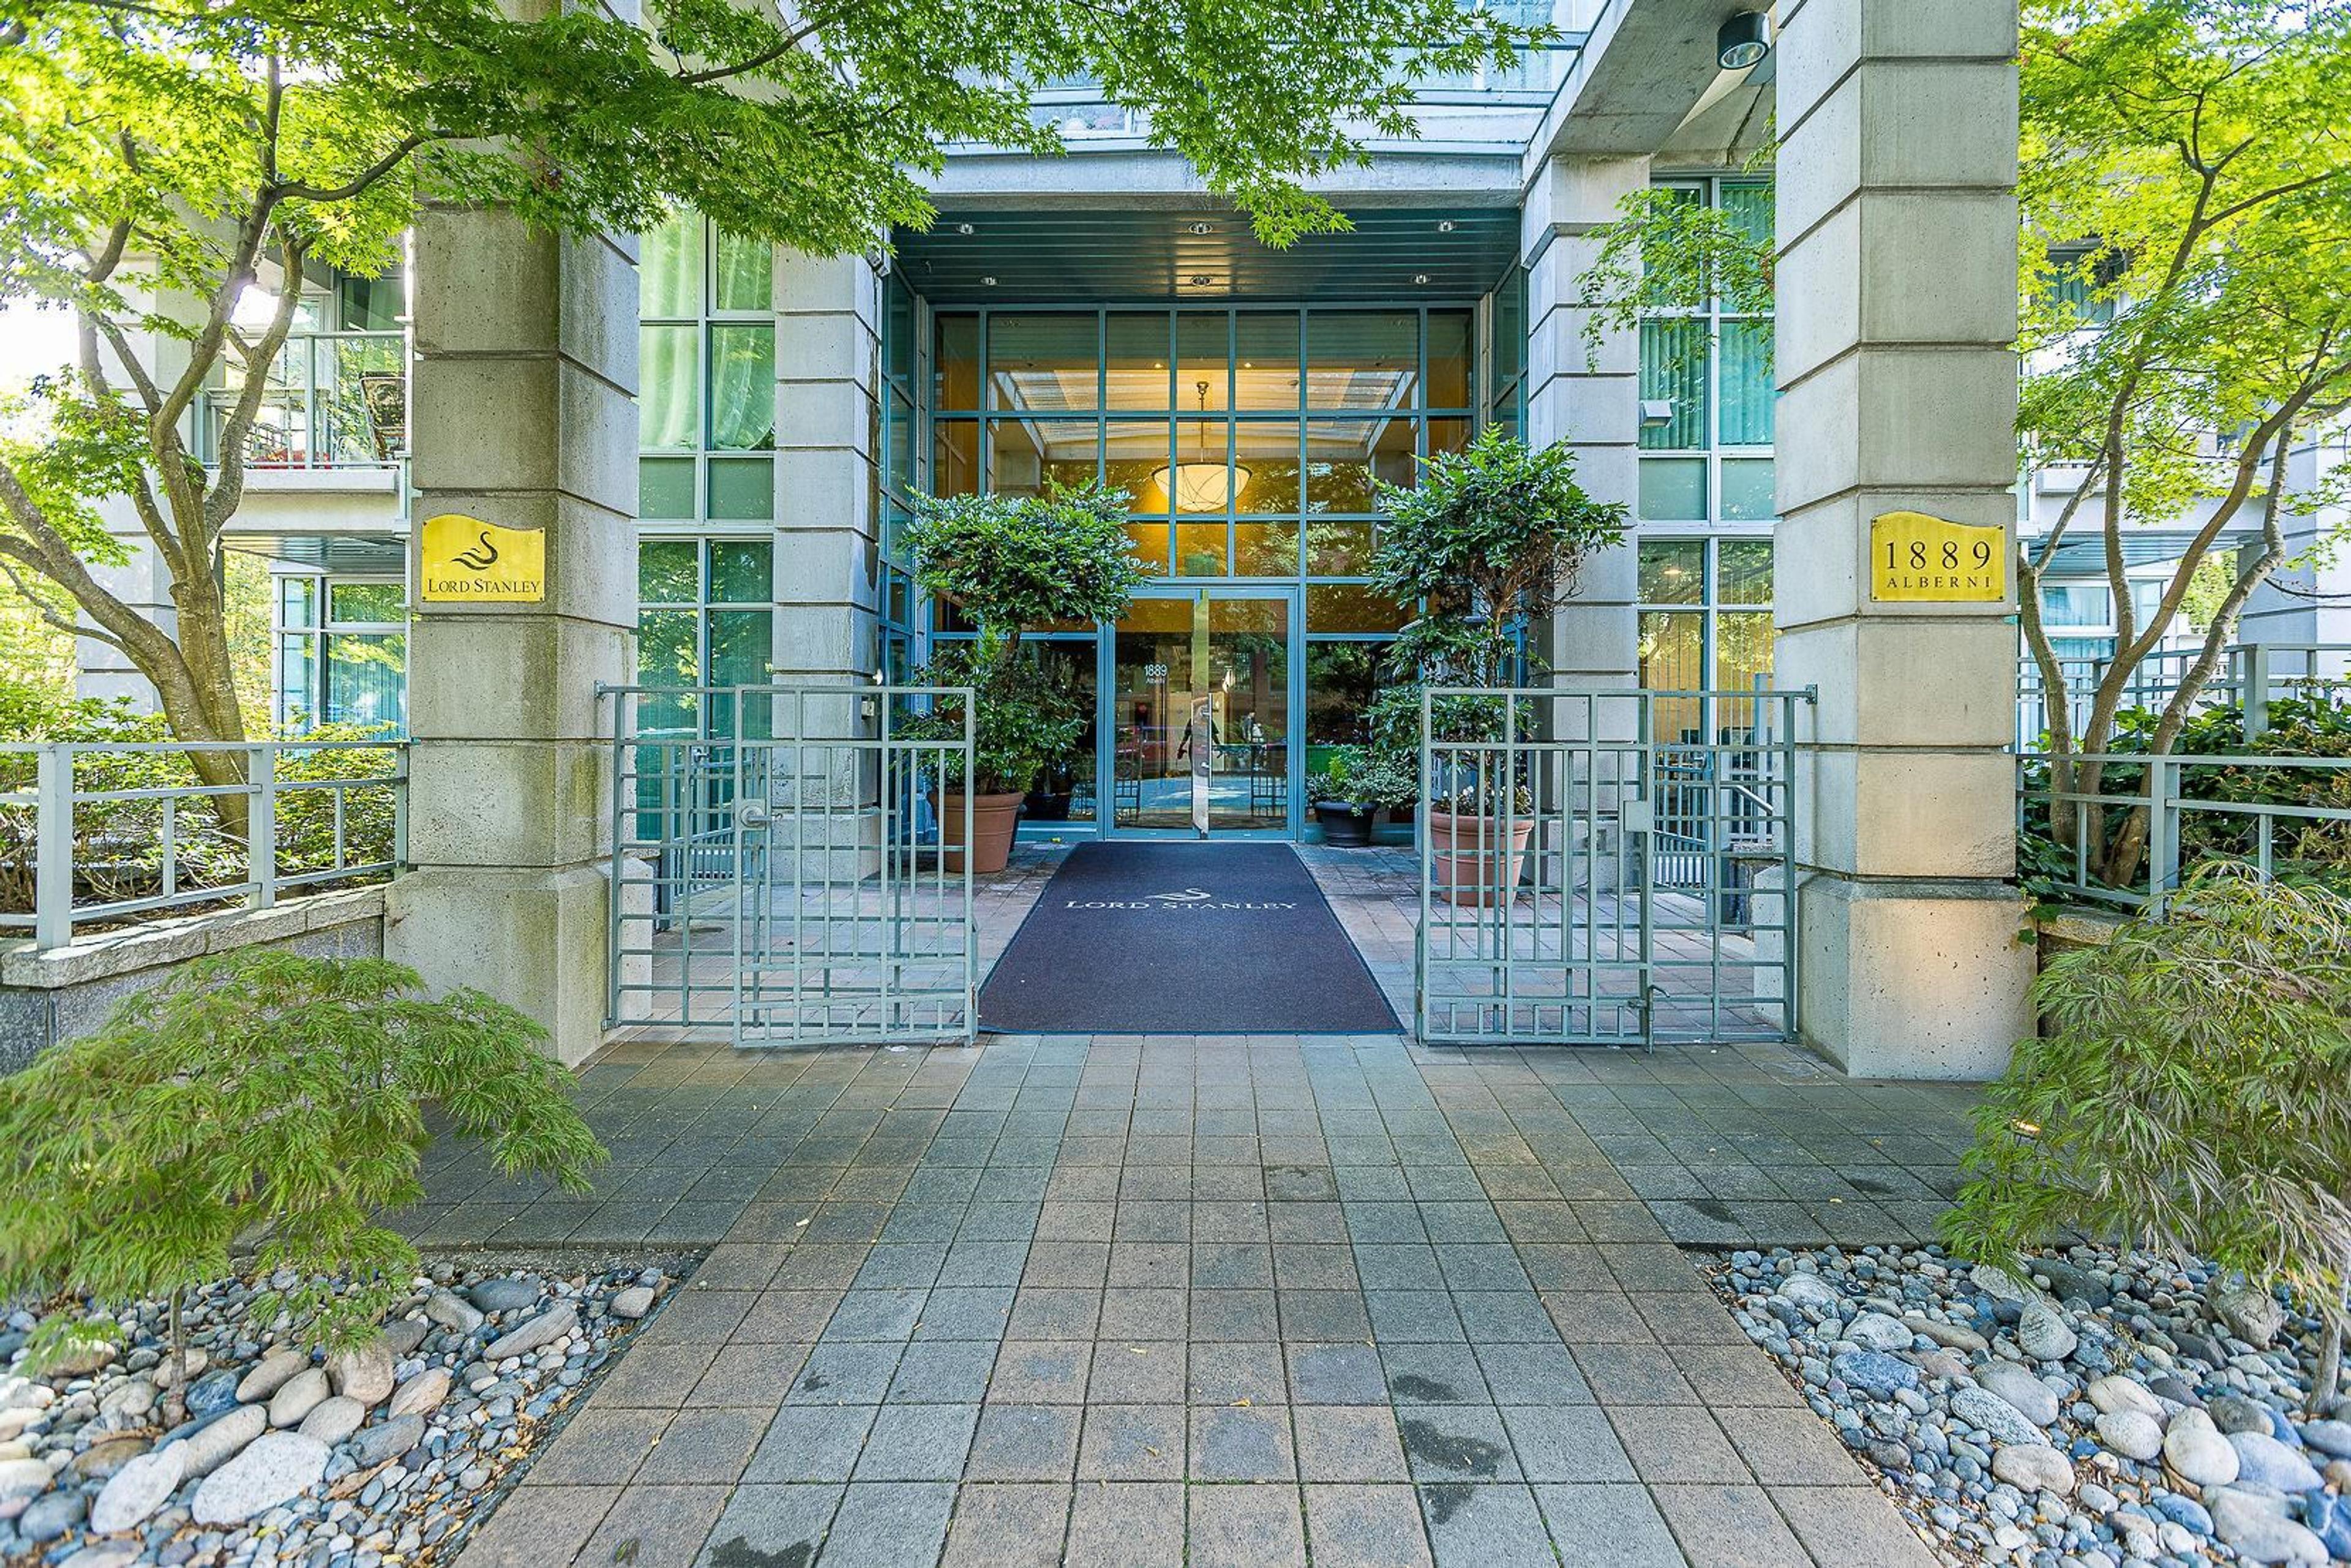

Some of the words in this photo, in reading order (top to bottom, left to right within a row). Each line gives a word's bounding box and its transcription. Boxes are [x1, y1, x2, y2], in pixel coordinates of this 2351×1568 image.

[1886, 541, 1990, 570] 1889
[1886, 576, 1990, 588] ALBERNI
[1144, 664, 1168, 677] 1889
